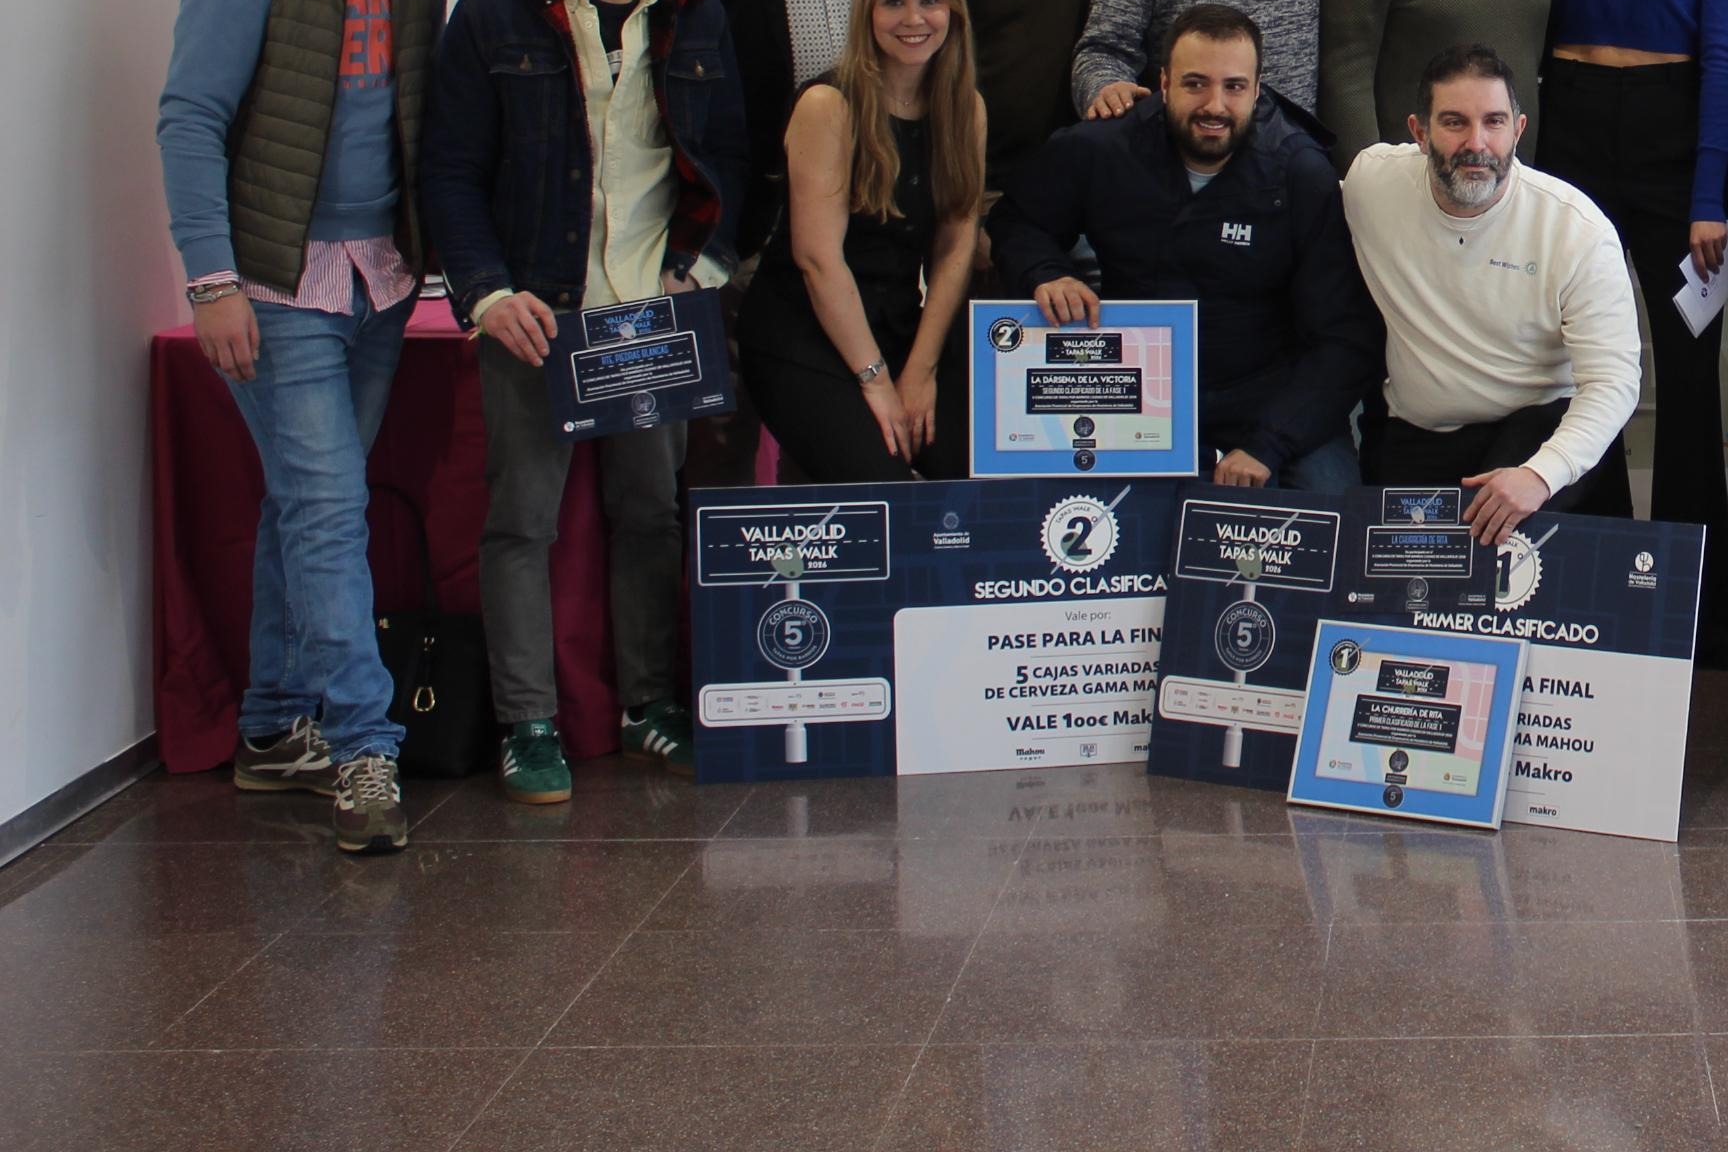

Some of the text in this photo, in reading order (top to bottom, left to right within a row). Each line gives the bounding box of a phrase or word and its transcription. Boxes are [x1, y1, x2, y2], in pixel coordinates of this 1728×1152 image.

[1031, 376, 1041, 384] LA
[1077, 376, 1088, 384] DE
[1089, 376, 1099, 384] LA
[1100, 375, 1137, 384] VICTORIA
[741, 524, 846, 542] VALLADOLID
[933, 537, 970, 545] Valladolid
[1216, 523, 1301, 546] VALLADOLID
[749, 545, 838, 561] TAPAS WALK
[1219, 545, 1292, 565] TAPAS WALK
[974, 574, 1169, 599] SEGUNDO CLASIFICA
[769, 606, 818, 625] CONCURSO
[1065, 611, 1111, 622] Vale por:
[1226, 607, 1266, 628] CONCURSO
[1413, 611, 1599, 644] PRIMER CLASIFICADO
[988, 627, 1162, 650] PASE PARA LA FIN
[1016, 666, 1029, 684] 5
[1033, 664, 1078, 681] CAJAS
[984, 688, 1005, 699] DE
[1009, 683, 1079, 698] CERVEZA
[1082, 681, 1129, 696] GAMA
[1539, 678, 1594, 699] FINAL
[1007, 714, 1057, 732] VALE
[1113, 708, 1152, 726] Mak
[1371, 704, 1380, 712] LA
[1419, 709, 1428, 718] DE
[1429, 710, 1443, 719] RITA
[1517, 712, 1572, 730] RIADAS
[1536, 733, 1594, 753] MAHOU
[1515, 760, 1573, 783] Makro
[1529, 805, 1557, 817] makro
